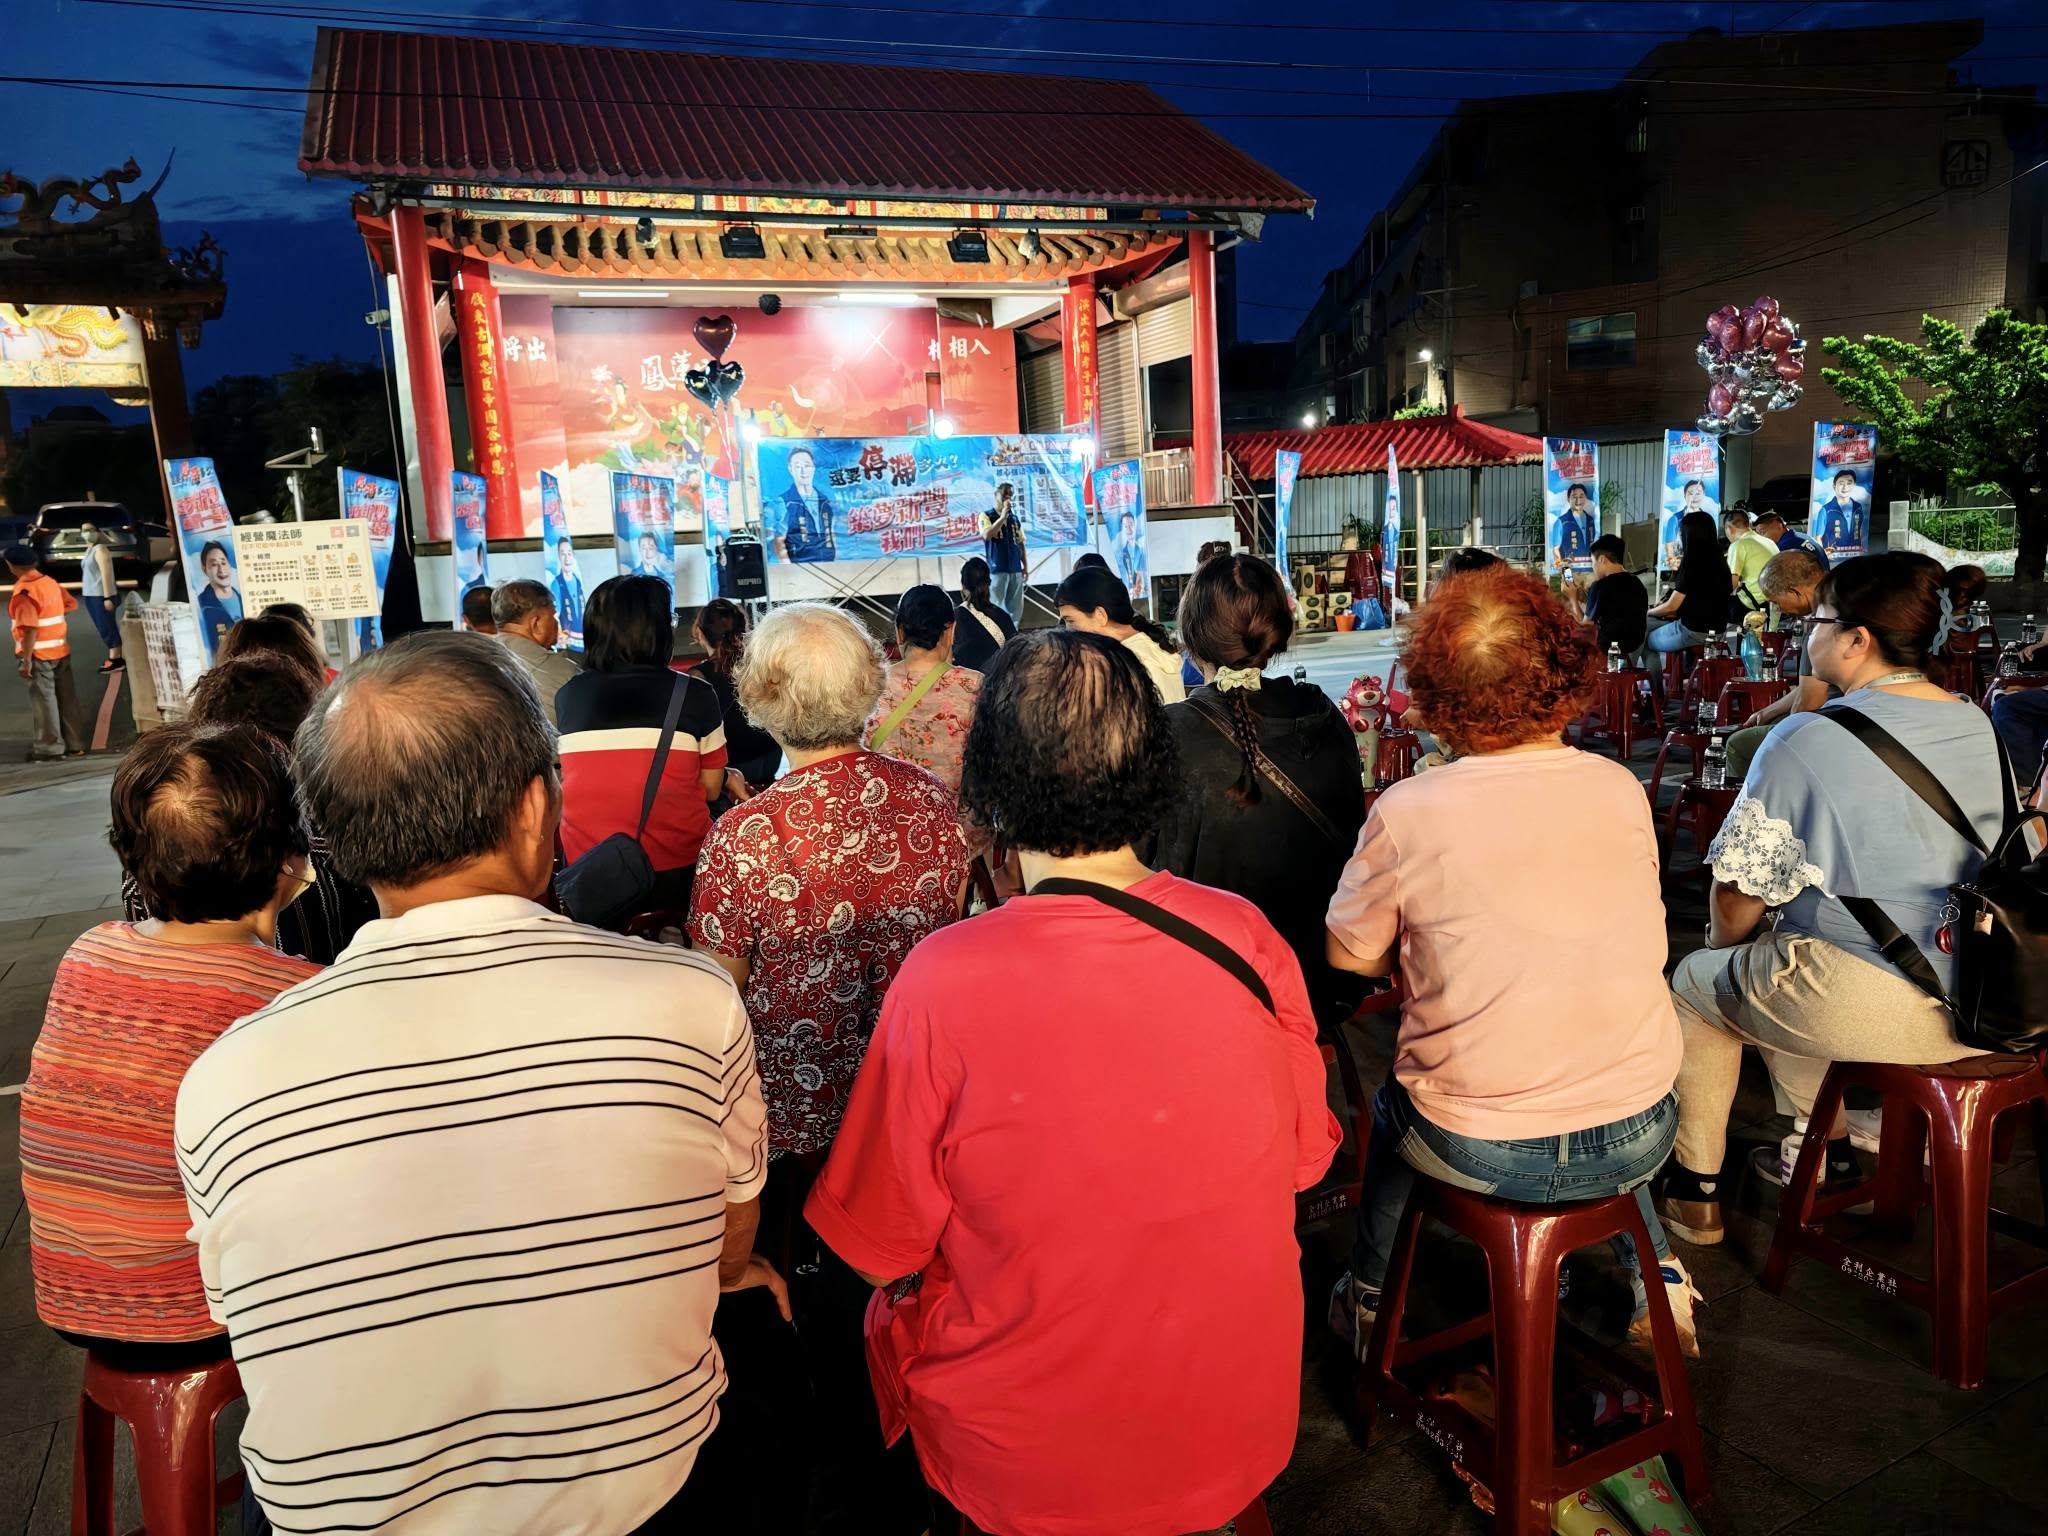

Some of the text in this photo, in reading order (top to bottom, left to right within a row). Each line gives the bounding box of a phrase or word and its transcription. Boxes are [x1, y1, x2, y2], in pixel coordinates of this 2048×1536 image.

[240, 528, 302, 543] 經營魔法師
